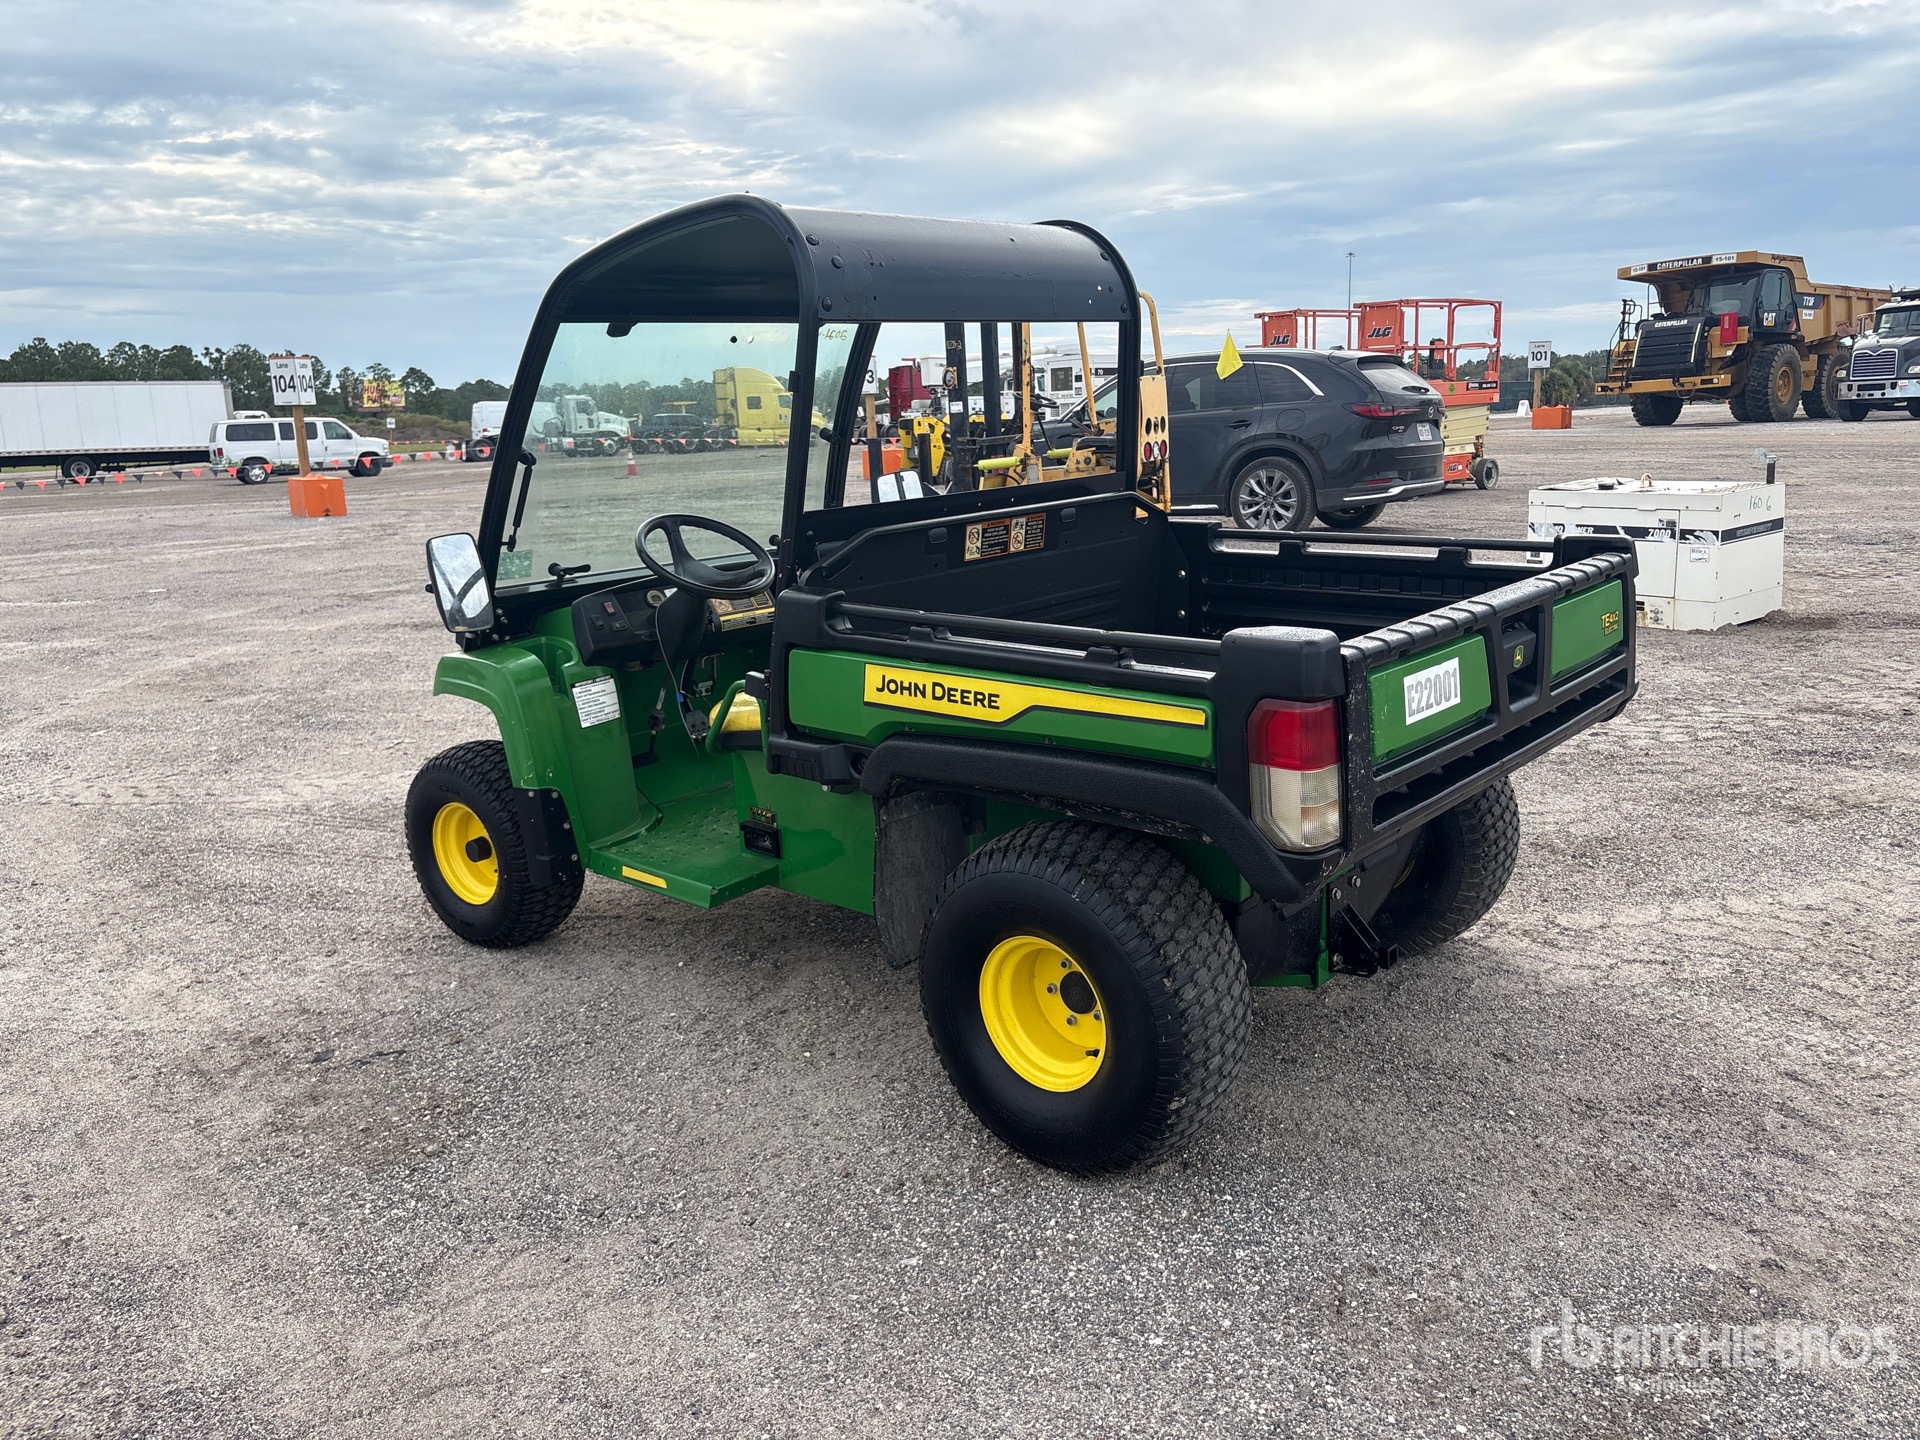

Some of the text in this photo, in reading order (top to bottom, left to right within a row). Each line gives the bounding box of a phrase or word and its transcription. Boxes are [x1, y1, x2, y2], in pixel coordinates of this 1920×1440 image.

[1656, 258, 1703, 270] CATERPILLAR
[1654, 319, 1688, 328] CATERPILLAR
[1763, 312, 1776, 326] CAT
[1367, 326, 1394, 338] JLG
[1269, 335, 1291, 346] JLG
[1530, 350, 1547, 361] 101
[866, 369, 875, 384] 3
[272, 374, 297, 393] 104
[297, 374, 314, 393] 104
[1648, 528, 1672, 538] 7000
[876, 674, 1000, 710] JOHN DEERE
[1406, 667, 1459, 718] E22001
